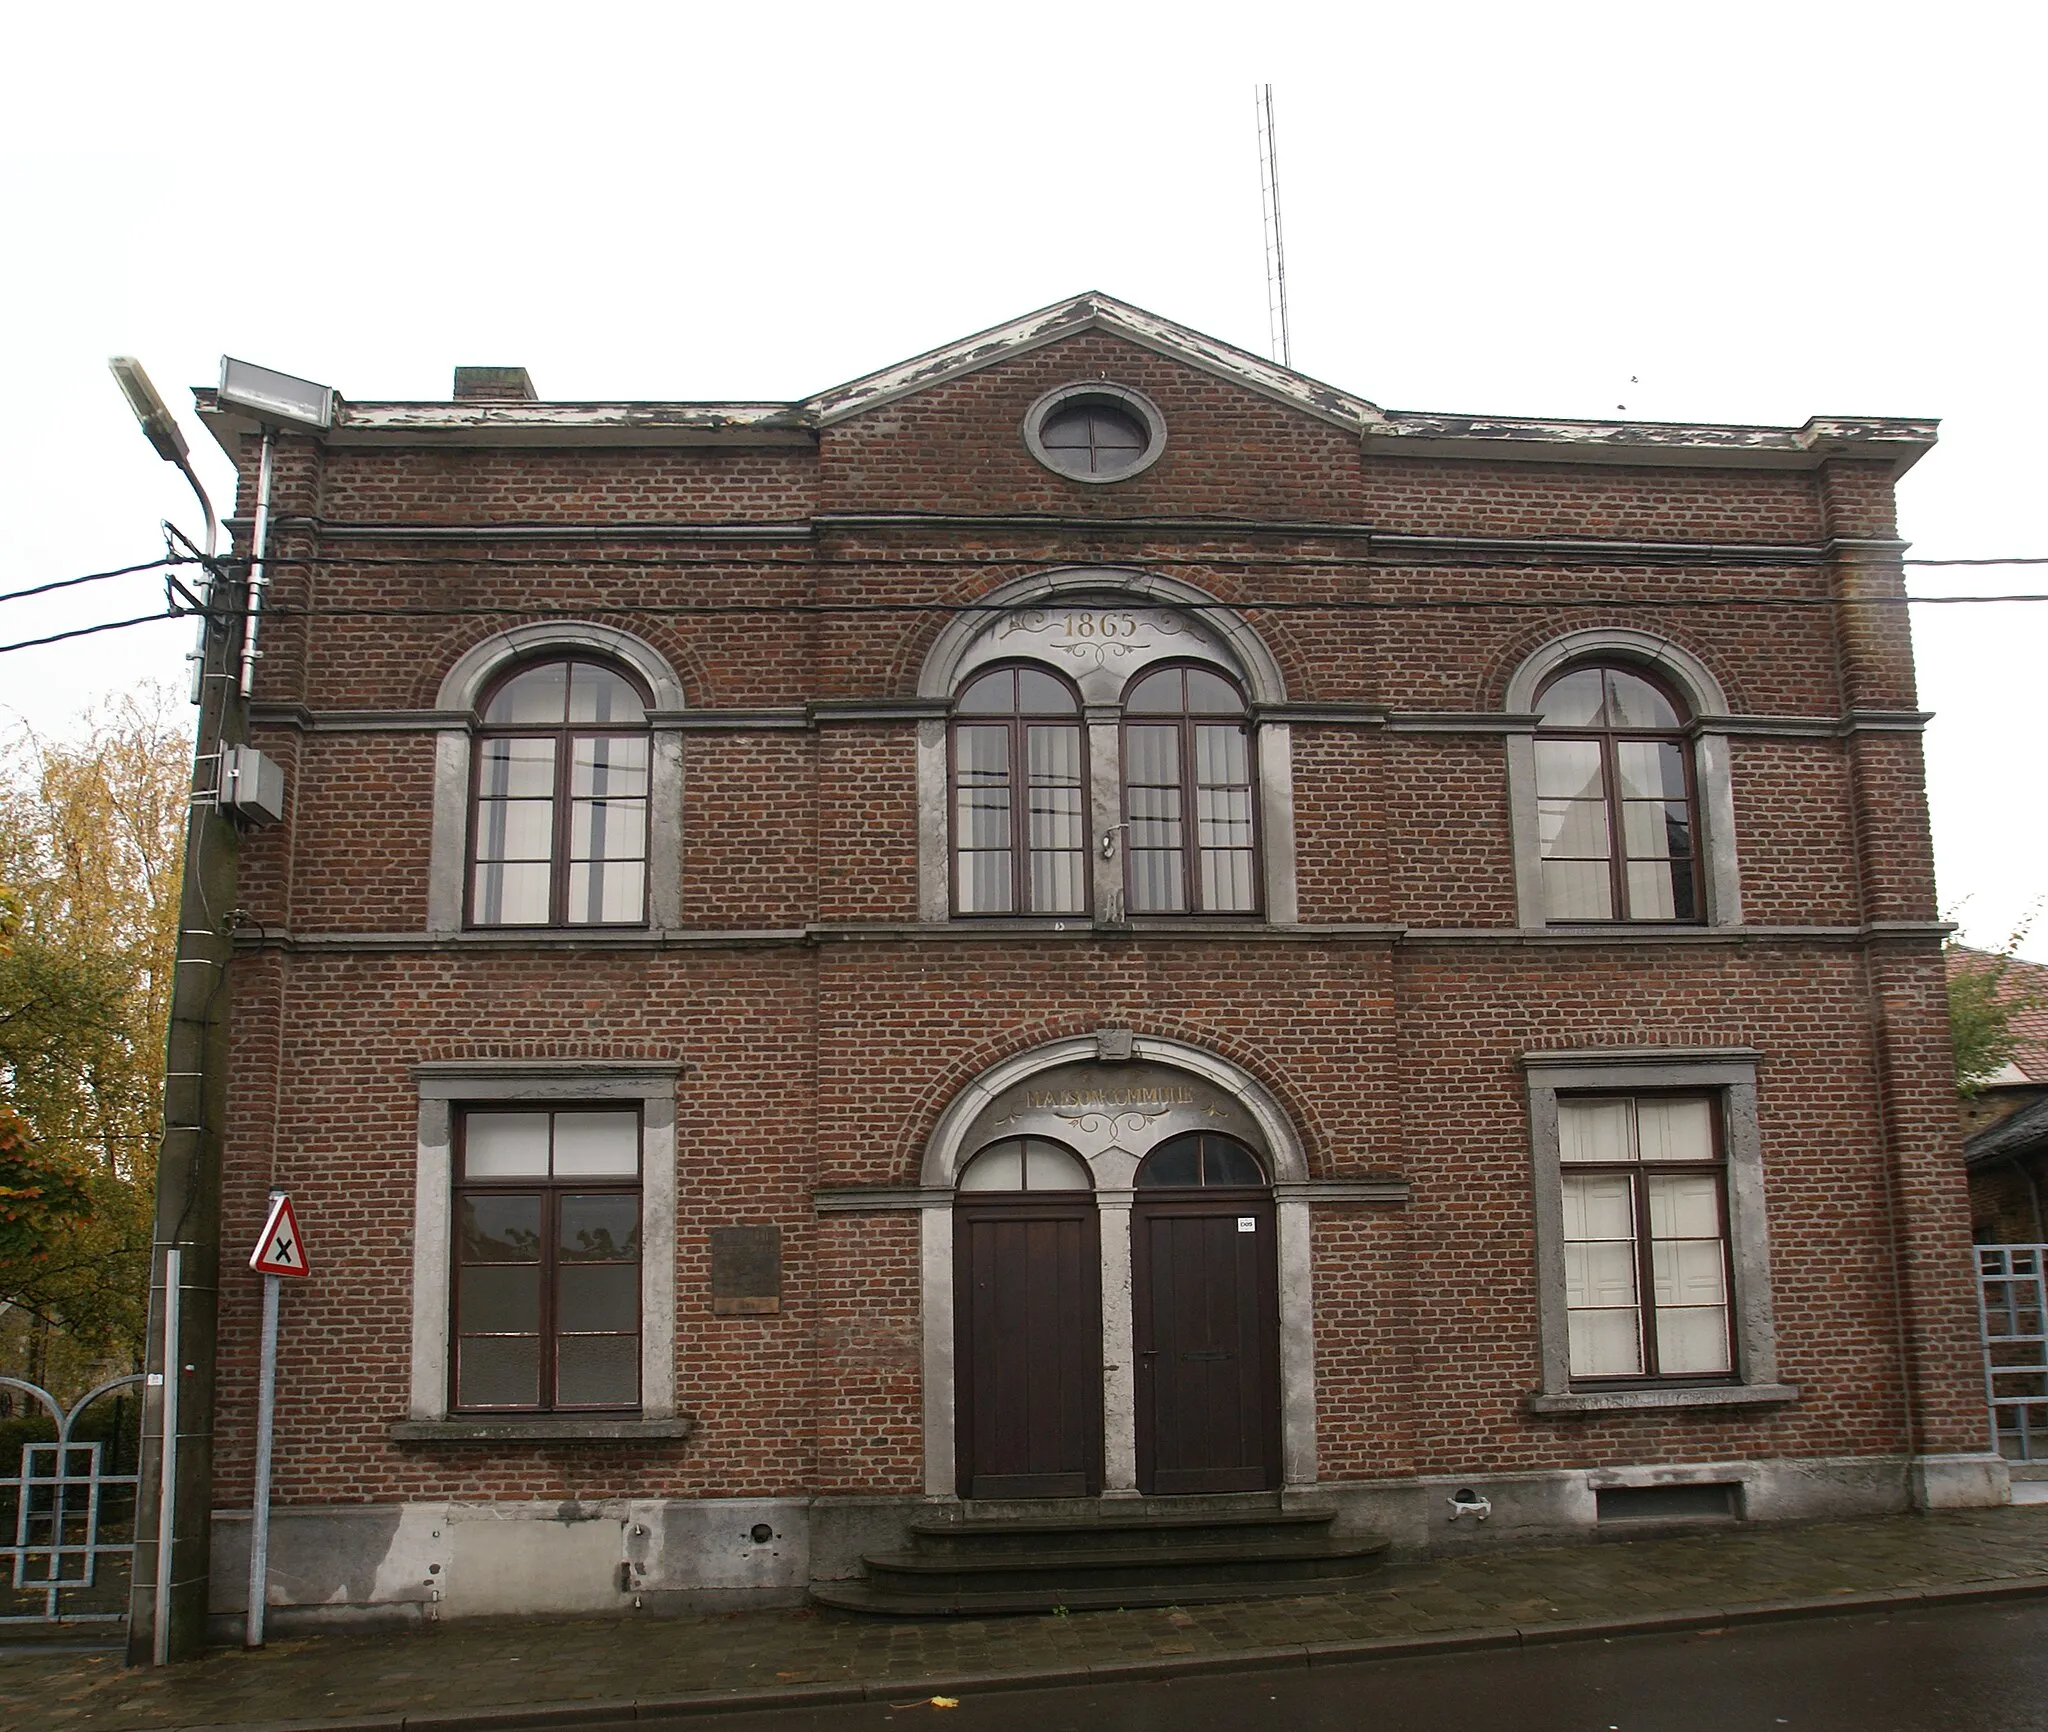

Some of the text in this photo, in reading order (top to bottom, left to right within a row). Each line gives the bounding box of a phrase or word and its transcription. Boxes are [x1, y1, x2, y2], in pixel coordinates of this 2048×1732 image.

[1063, 612, 1137, 638] 1865
[1026, 1087, 1193, 1108] MAISON COMMUNE
